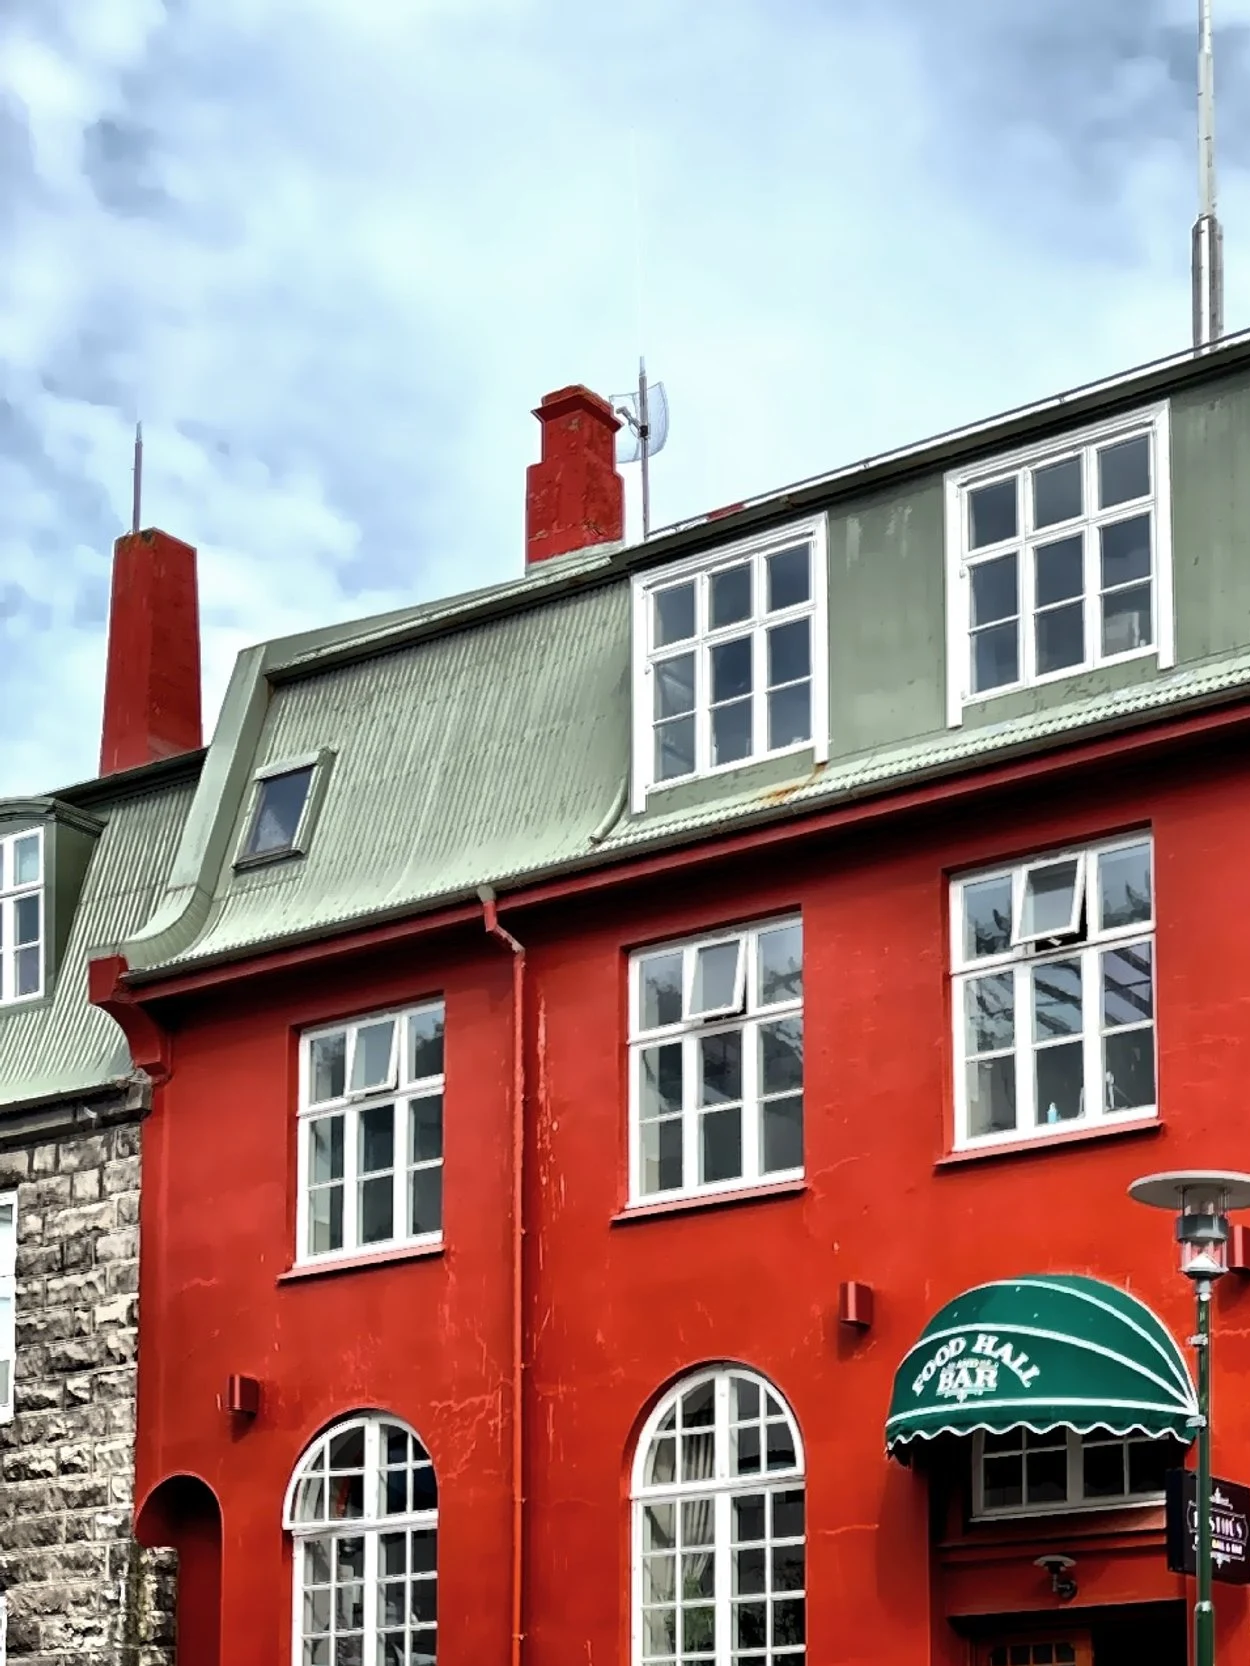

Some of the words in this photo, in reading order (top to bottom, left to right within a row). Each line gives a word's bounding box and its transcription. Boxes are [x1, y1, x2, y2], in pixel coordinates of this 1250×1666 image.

[912, 1337, 966, 1396] FOOD
[971, 1333, 1040, 1388] HALL
[938, 1366, 998, 1392] BAR
